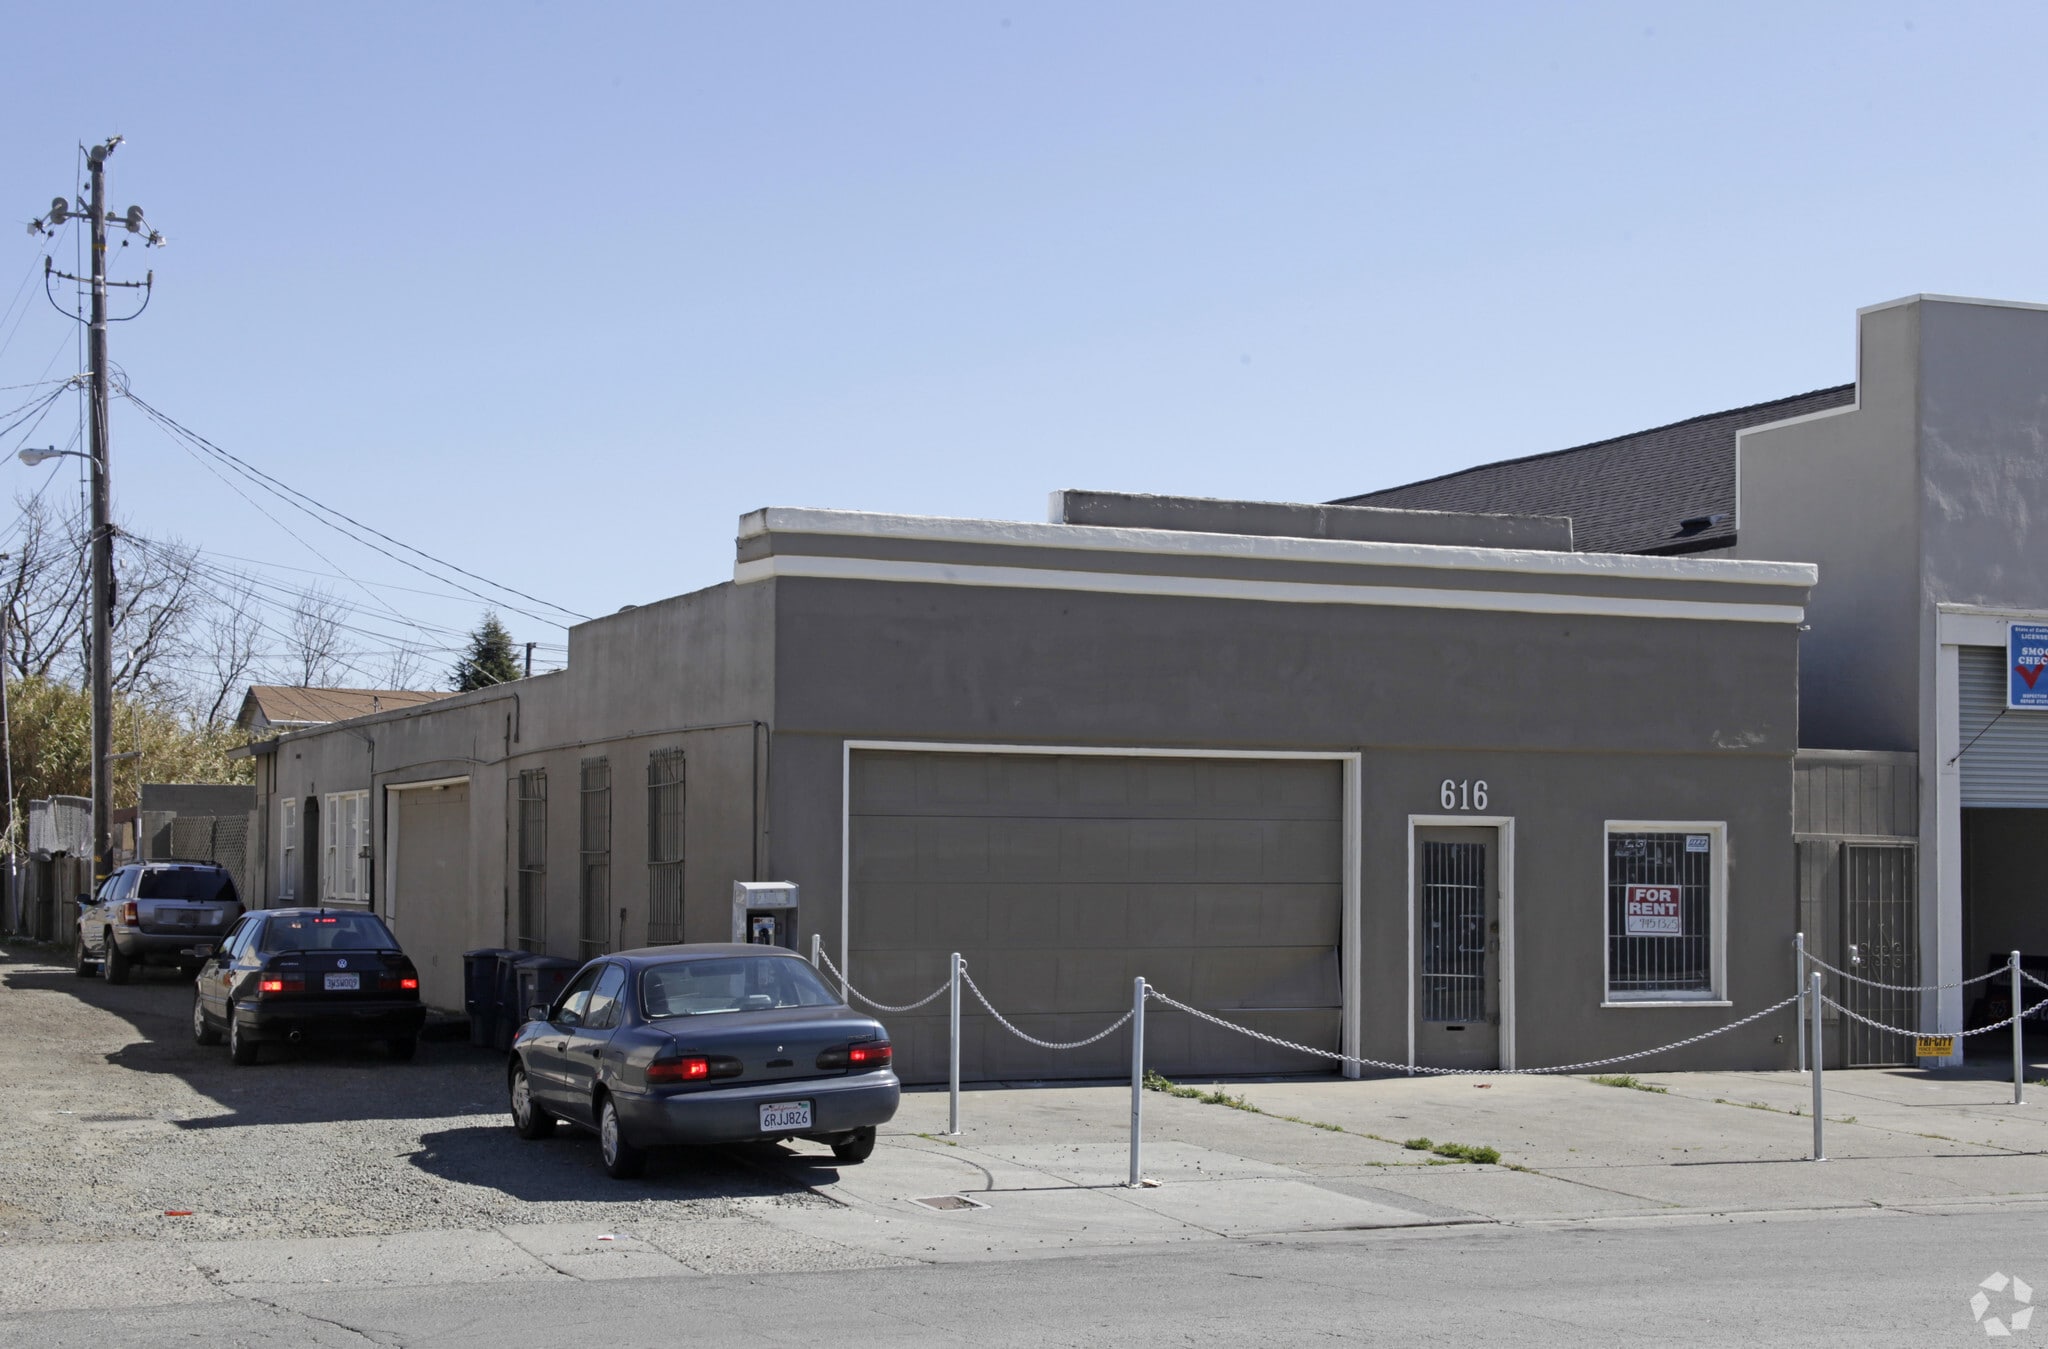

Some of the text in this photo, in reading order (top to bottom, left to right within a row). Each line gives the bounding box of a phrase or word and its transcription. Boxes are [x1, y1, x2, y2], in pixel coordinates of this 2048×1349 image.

[1440, 778, 1488, 811] 616
[1635, 888, 1672, 902] FOR
[1629, 902, 1677, 915] RENT
[764, 1110, 808, 1127] 6RJJ826
